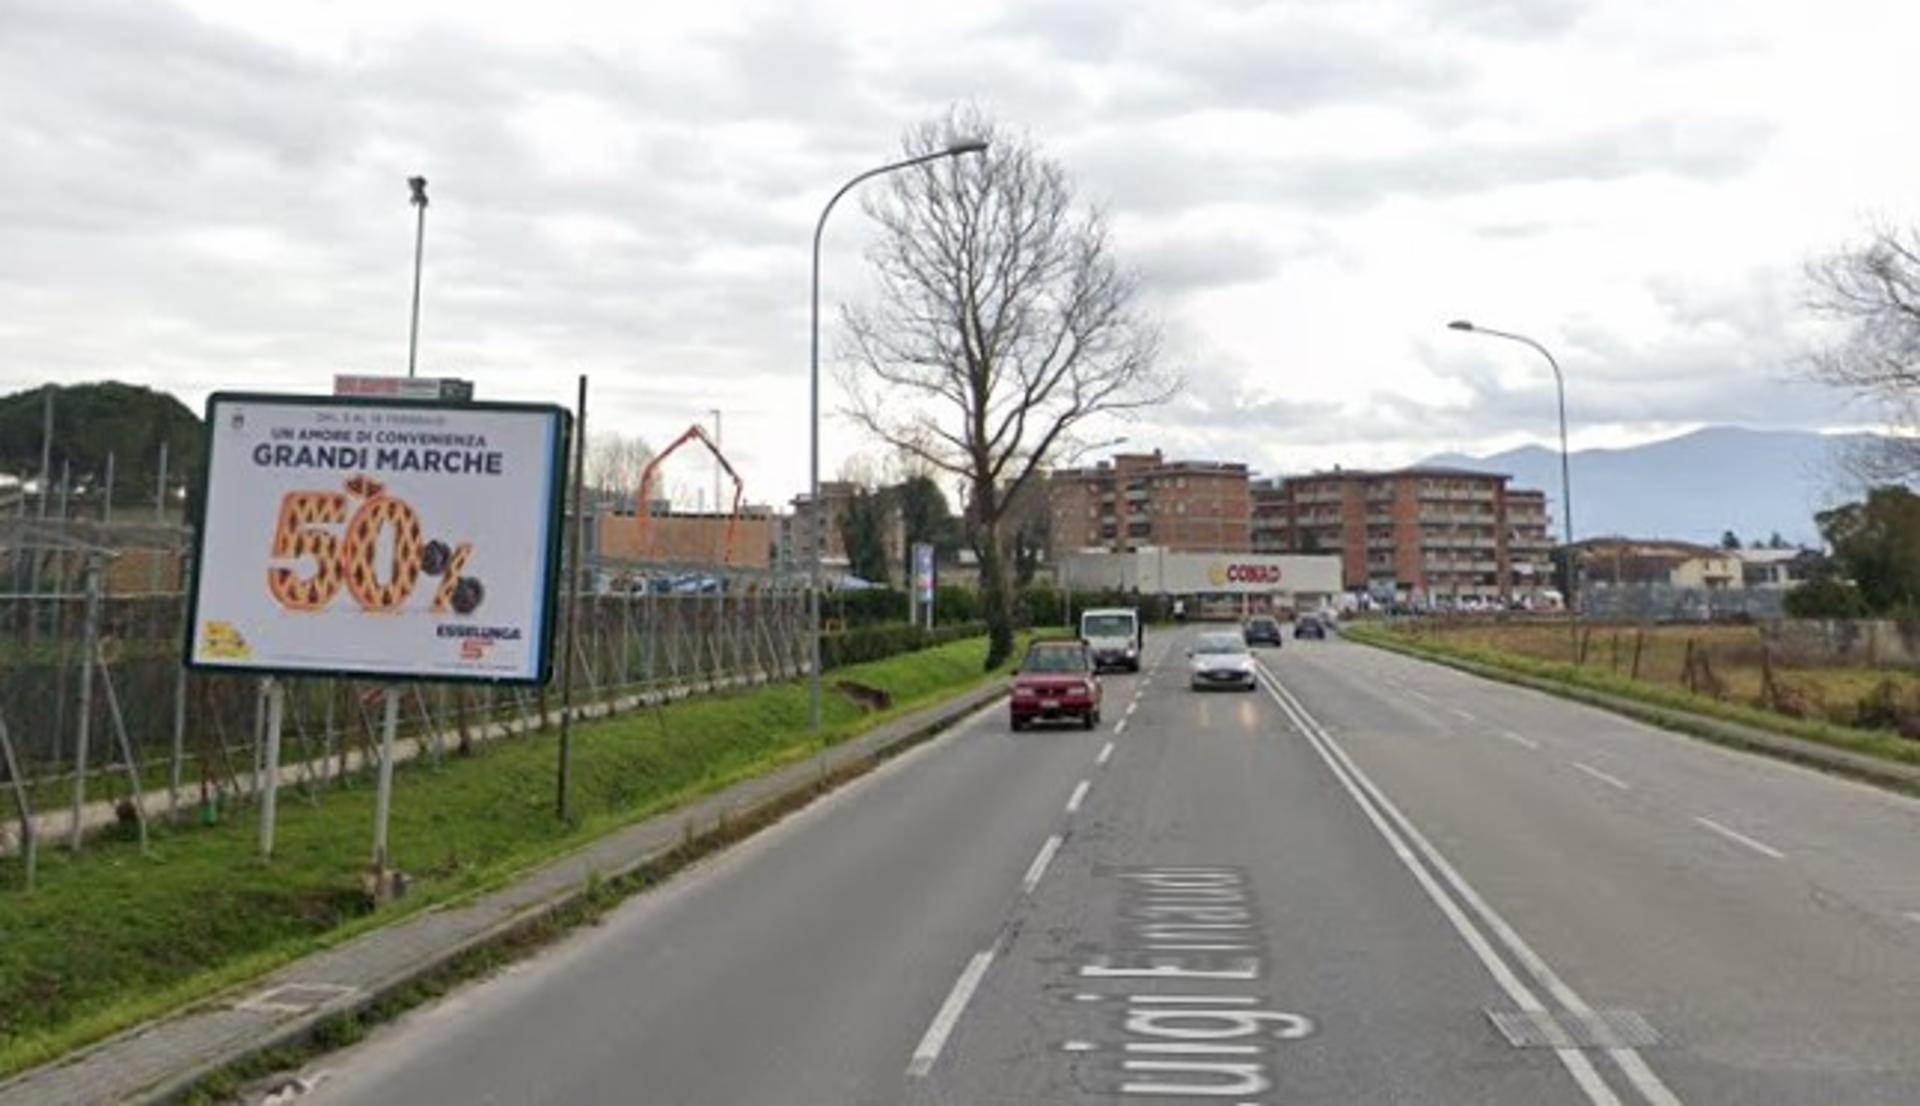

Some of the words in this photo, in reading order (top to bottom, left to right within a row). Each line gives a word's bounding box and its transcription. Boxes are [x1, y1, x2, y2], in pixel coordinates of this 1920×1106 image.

[271, 428, 295, 440] UN
[299, 430, 350, 442] AMORE
[356, 431, 372, 443] DI
[376, 431, 486, 447] CONVENIENZA
[253, 444, 367, 470] GRANDI
[376, 448, 503, 475] MARCHE
[267, 488, 485, 616] 50%
[1227, 564, 1281, 583] CONAD
[436, 625, 521, 640] ESSELUNGA
